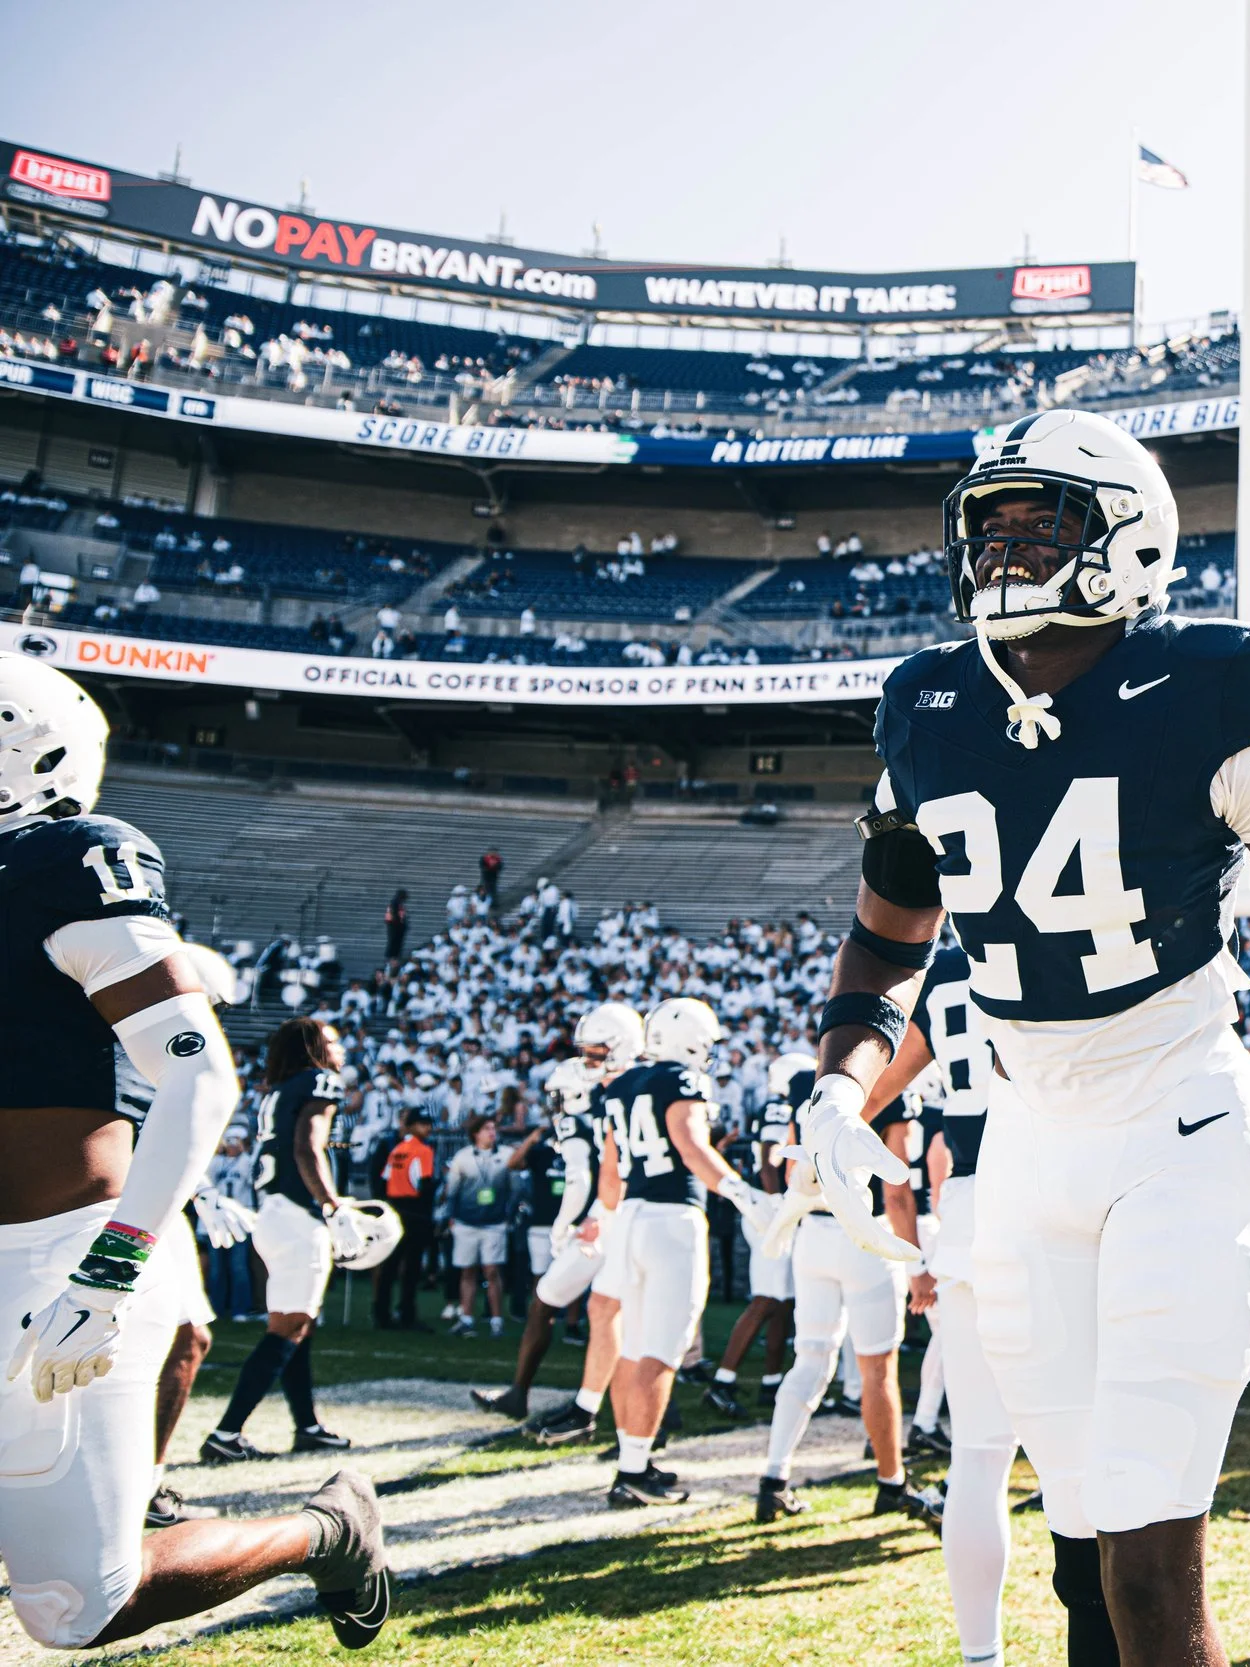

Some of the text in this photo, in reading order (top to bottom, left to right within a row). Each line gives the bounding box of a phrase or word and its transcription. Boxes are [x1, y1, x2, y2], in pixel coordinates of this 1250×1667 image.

[27, 160, 98, 195] bryant
[645, 276, 818, 312] WHATEVER
[818, 286, 850, 313] IT
[357, 418, 528, 455] SCORE BIG!
[1114, 407, 1181, 435] CORE
[711, 435, 908, 464] PA LOTTERY ONLINE
[1000, 456, 1027, 466] STATE
[304, 666, 418, 689] OFFICIAL
[427, 672, 519, 692] COFFEE
[529, 677, 639, 695] SPONSOR
[648, 677, 679, 695] OF
[686, 676, 745, 693] PENN
[82, 841, 151, 905] 11
[915, 777, 1159, 1001] 24
